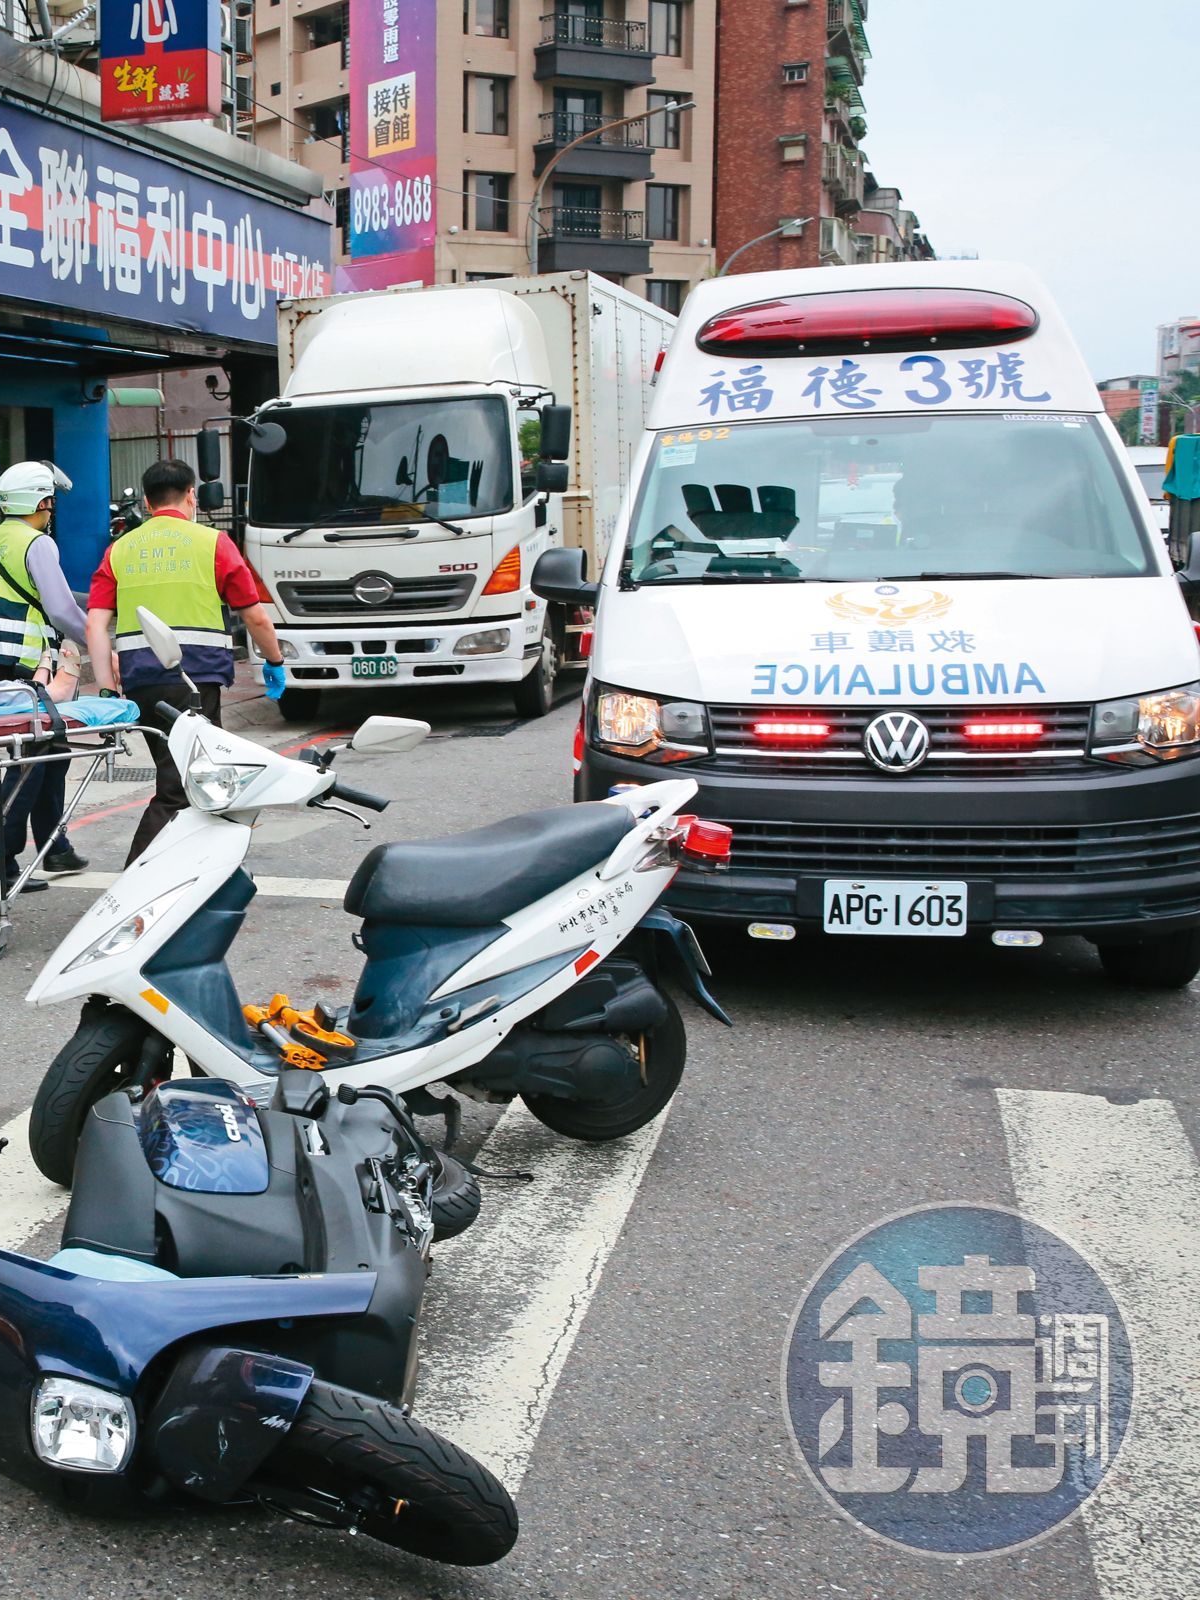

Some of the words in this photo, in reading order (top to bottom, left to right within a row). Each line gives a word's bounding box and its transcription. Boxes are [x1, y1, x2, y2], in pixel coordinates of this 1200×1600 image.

[113, 59, 159, 103] 生鮮
[373, 83, 410, 118] 接待
[374, 113, 410, 148] 會館
[354, 174, 432, 235] 8983-8688
[271, 246, 325, 300] 中正北店
[698, 352, 1052, 417] 福德3號
[140, 546, 176, 559] EMT
[439, 563, 478, 571] 500
[274, 570, 321, 578] HINO
[828, 893, 963, 927] APG-1603
